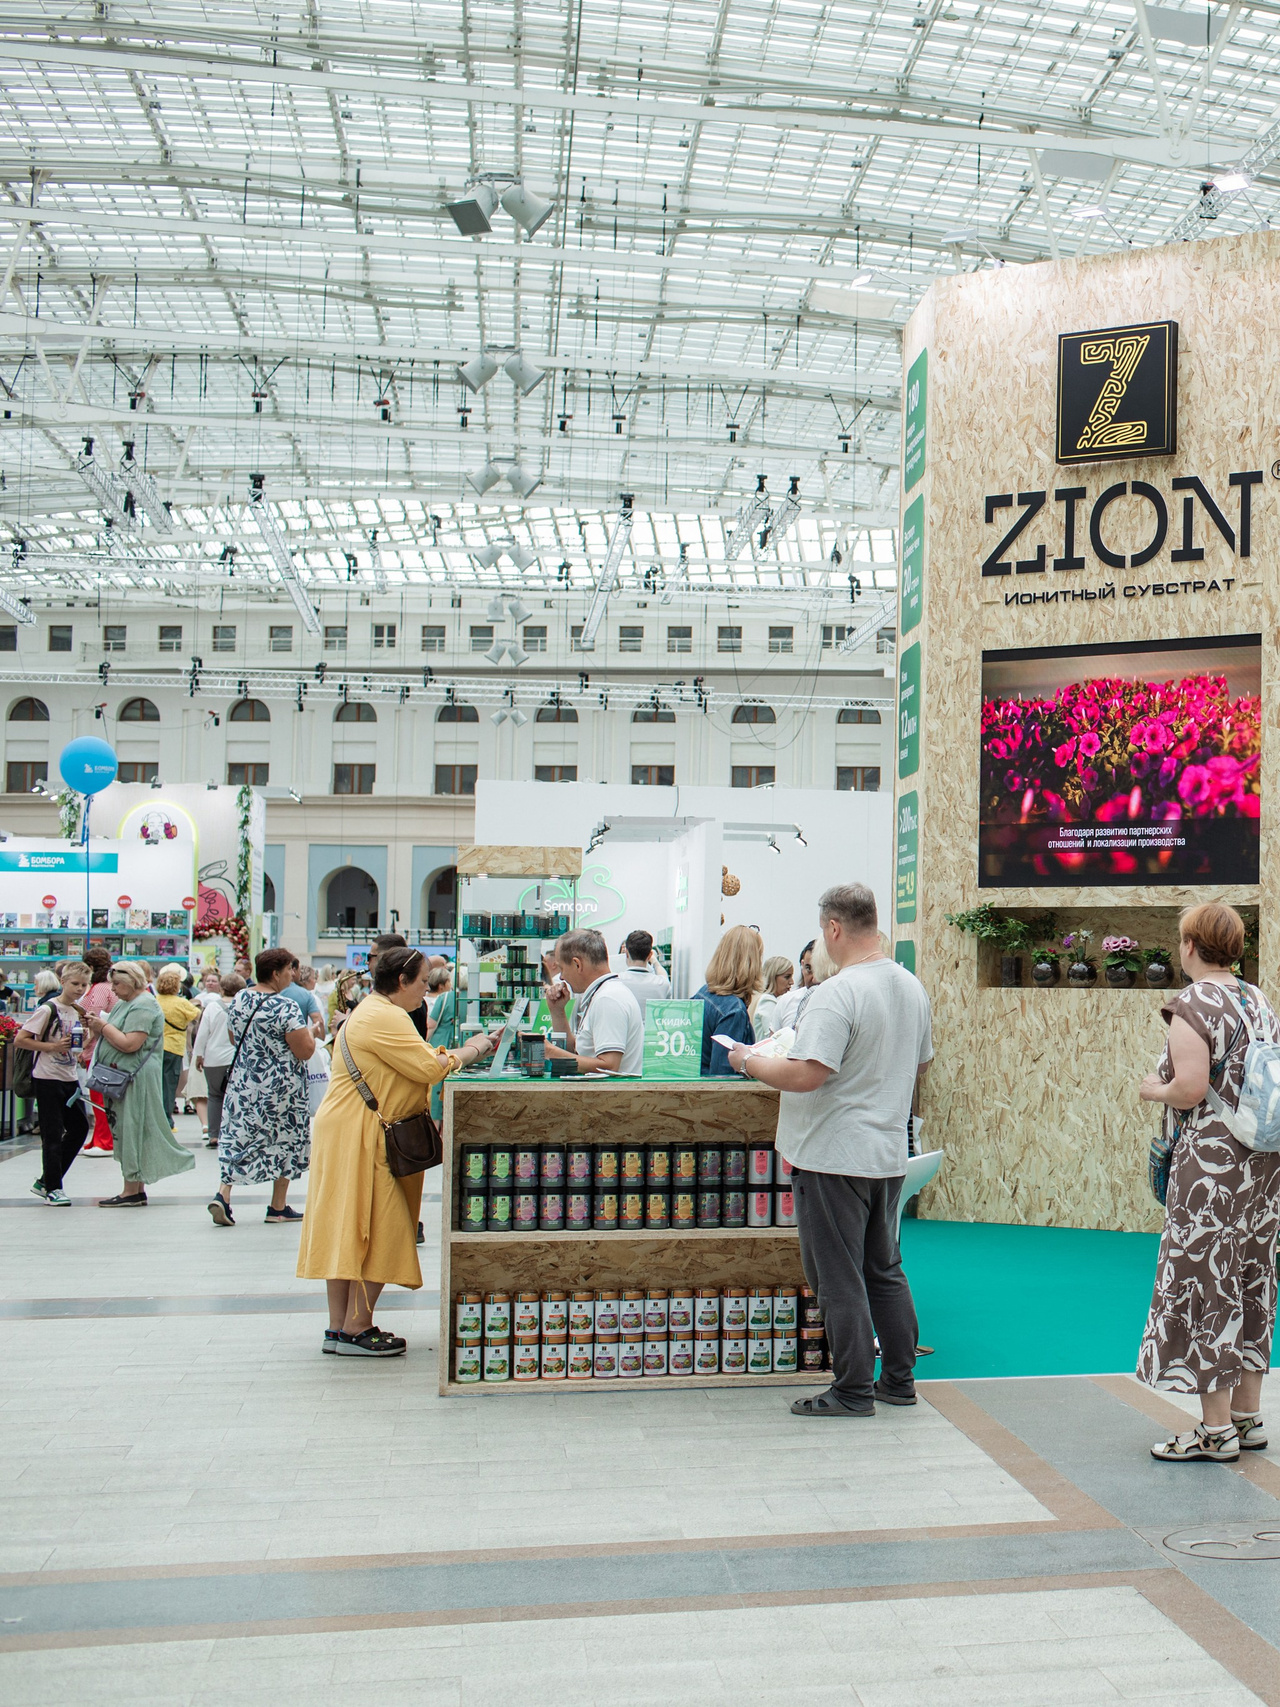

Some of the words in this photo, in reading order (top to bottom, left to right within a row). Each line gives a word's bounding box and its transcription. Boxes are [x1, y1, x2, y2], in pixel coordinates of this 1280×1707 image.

[982, 470, 1263, 577] ZION
[1004, 582, 1116, 606] ИОНИТНЫЙ
[1123, 578, 1235, 598] СУБСТРАТ
[1059, 827, 1094, 838] Благодаря
[1095, 827, 1128, 838] развитию
[1129, 826, 1172, 837] партнерских
[1048, 839, 1085, 848] отношений
[1093, 839, 1137, 848] локализации
[1137, 838, 1185, 848] производства
[31, 856, 65, 865] БОМБОРА
[544, 900, 598, 913] Semco.ru
[656, 1018, 692, 1028] СКИДКА
